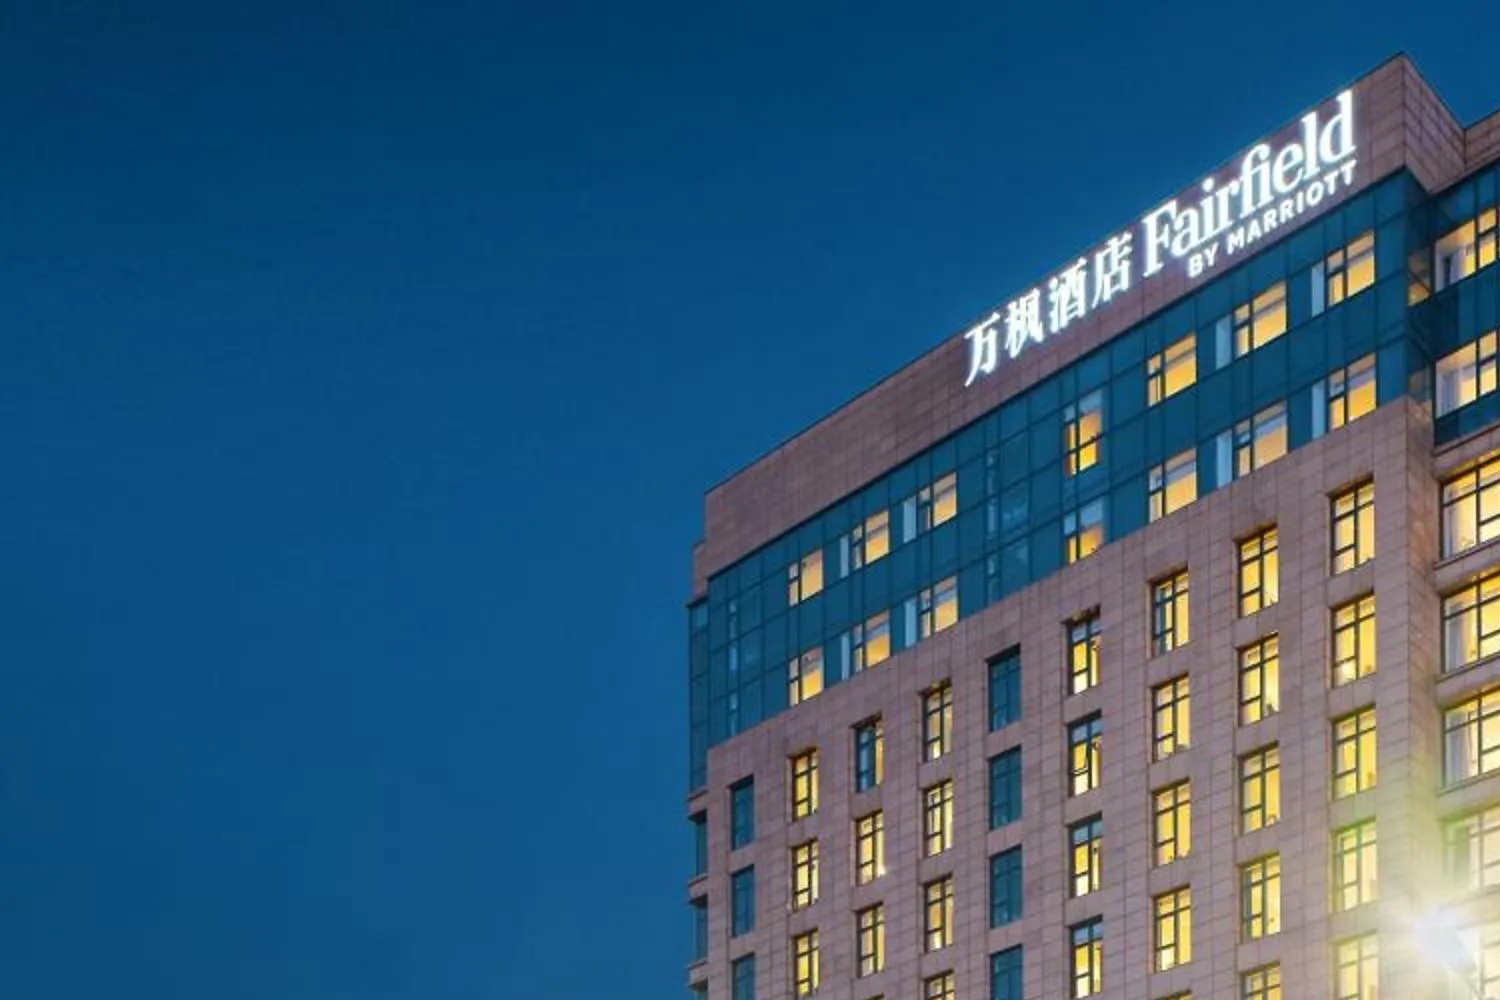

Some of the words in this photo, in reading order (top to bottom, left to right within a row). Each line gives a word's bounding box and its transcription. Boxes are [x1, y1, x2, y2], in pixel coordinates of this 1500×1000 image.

[964, 232, 1132, 387] 万枫酒店
[1142, 89, 1356, 278] Fairfield
[1187, 252, 1219, 279] BY
[1226, 160, 1357, 255] MARRIOTT
